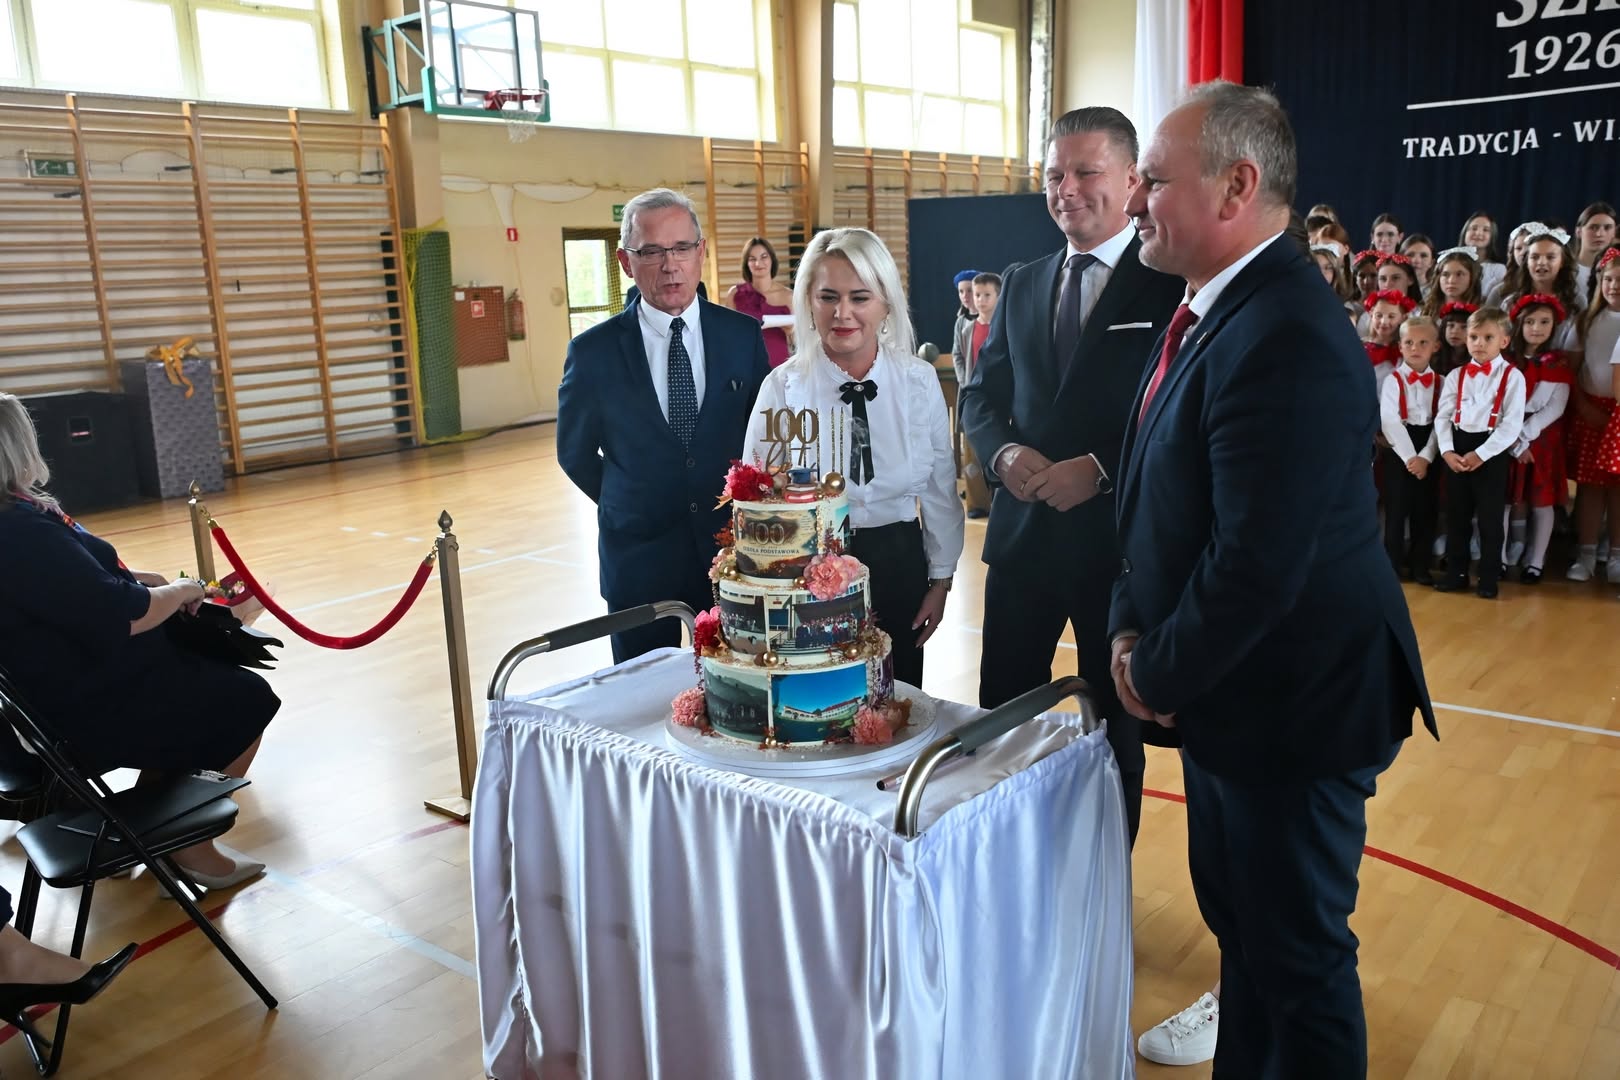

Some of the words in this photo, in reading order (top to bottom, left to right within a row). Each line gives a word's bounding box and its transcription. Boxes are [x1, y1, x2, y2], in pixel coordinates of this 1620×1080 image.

[1507, 29, 1620, 79] 1926
[1403, 128, 1540, 158] TRADYCJA
[1573, 119, 1620, 142] WI
[760, 408, 819, 444] 100
[748, 521, 785, 545] 100
